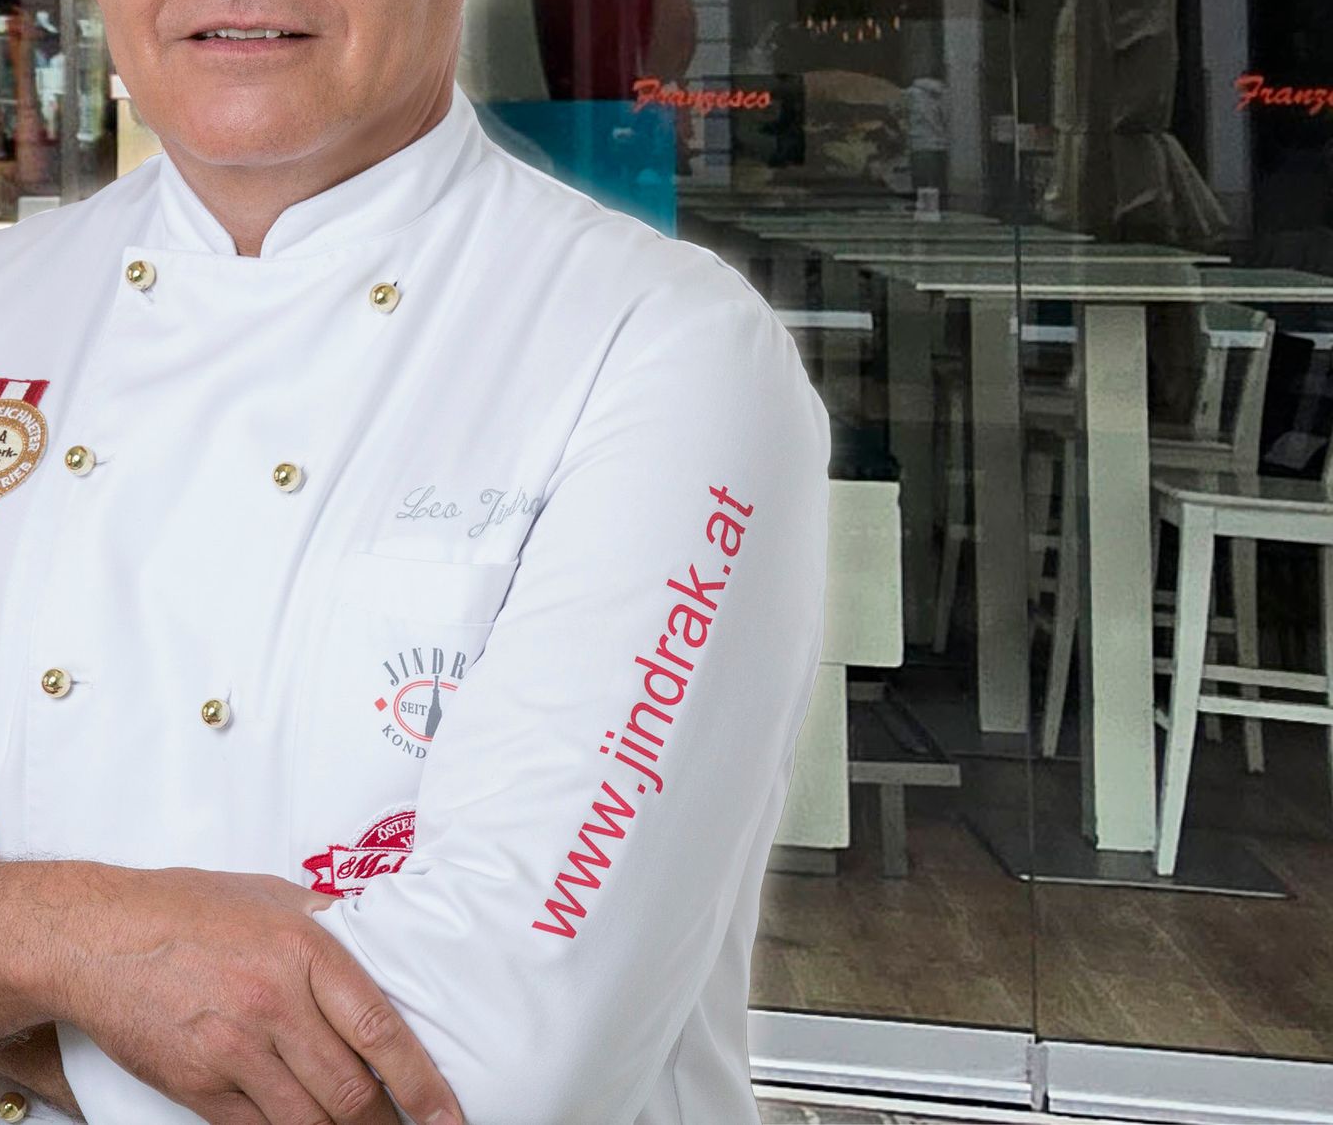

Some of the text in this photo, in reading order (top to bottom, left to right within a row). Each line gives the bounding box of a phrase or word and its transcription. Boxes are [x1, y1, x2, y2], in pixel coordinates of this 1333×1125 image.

[396, 485, 463, 521] Leo
[382, 647, 467, 687] JINDR
[400, 700, 428, 716] SEIT
[531, 484, 755, 940] www.jindrak.at
[381, 724, 427, 760] KOND
